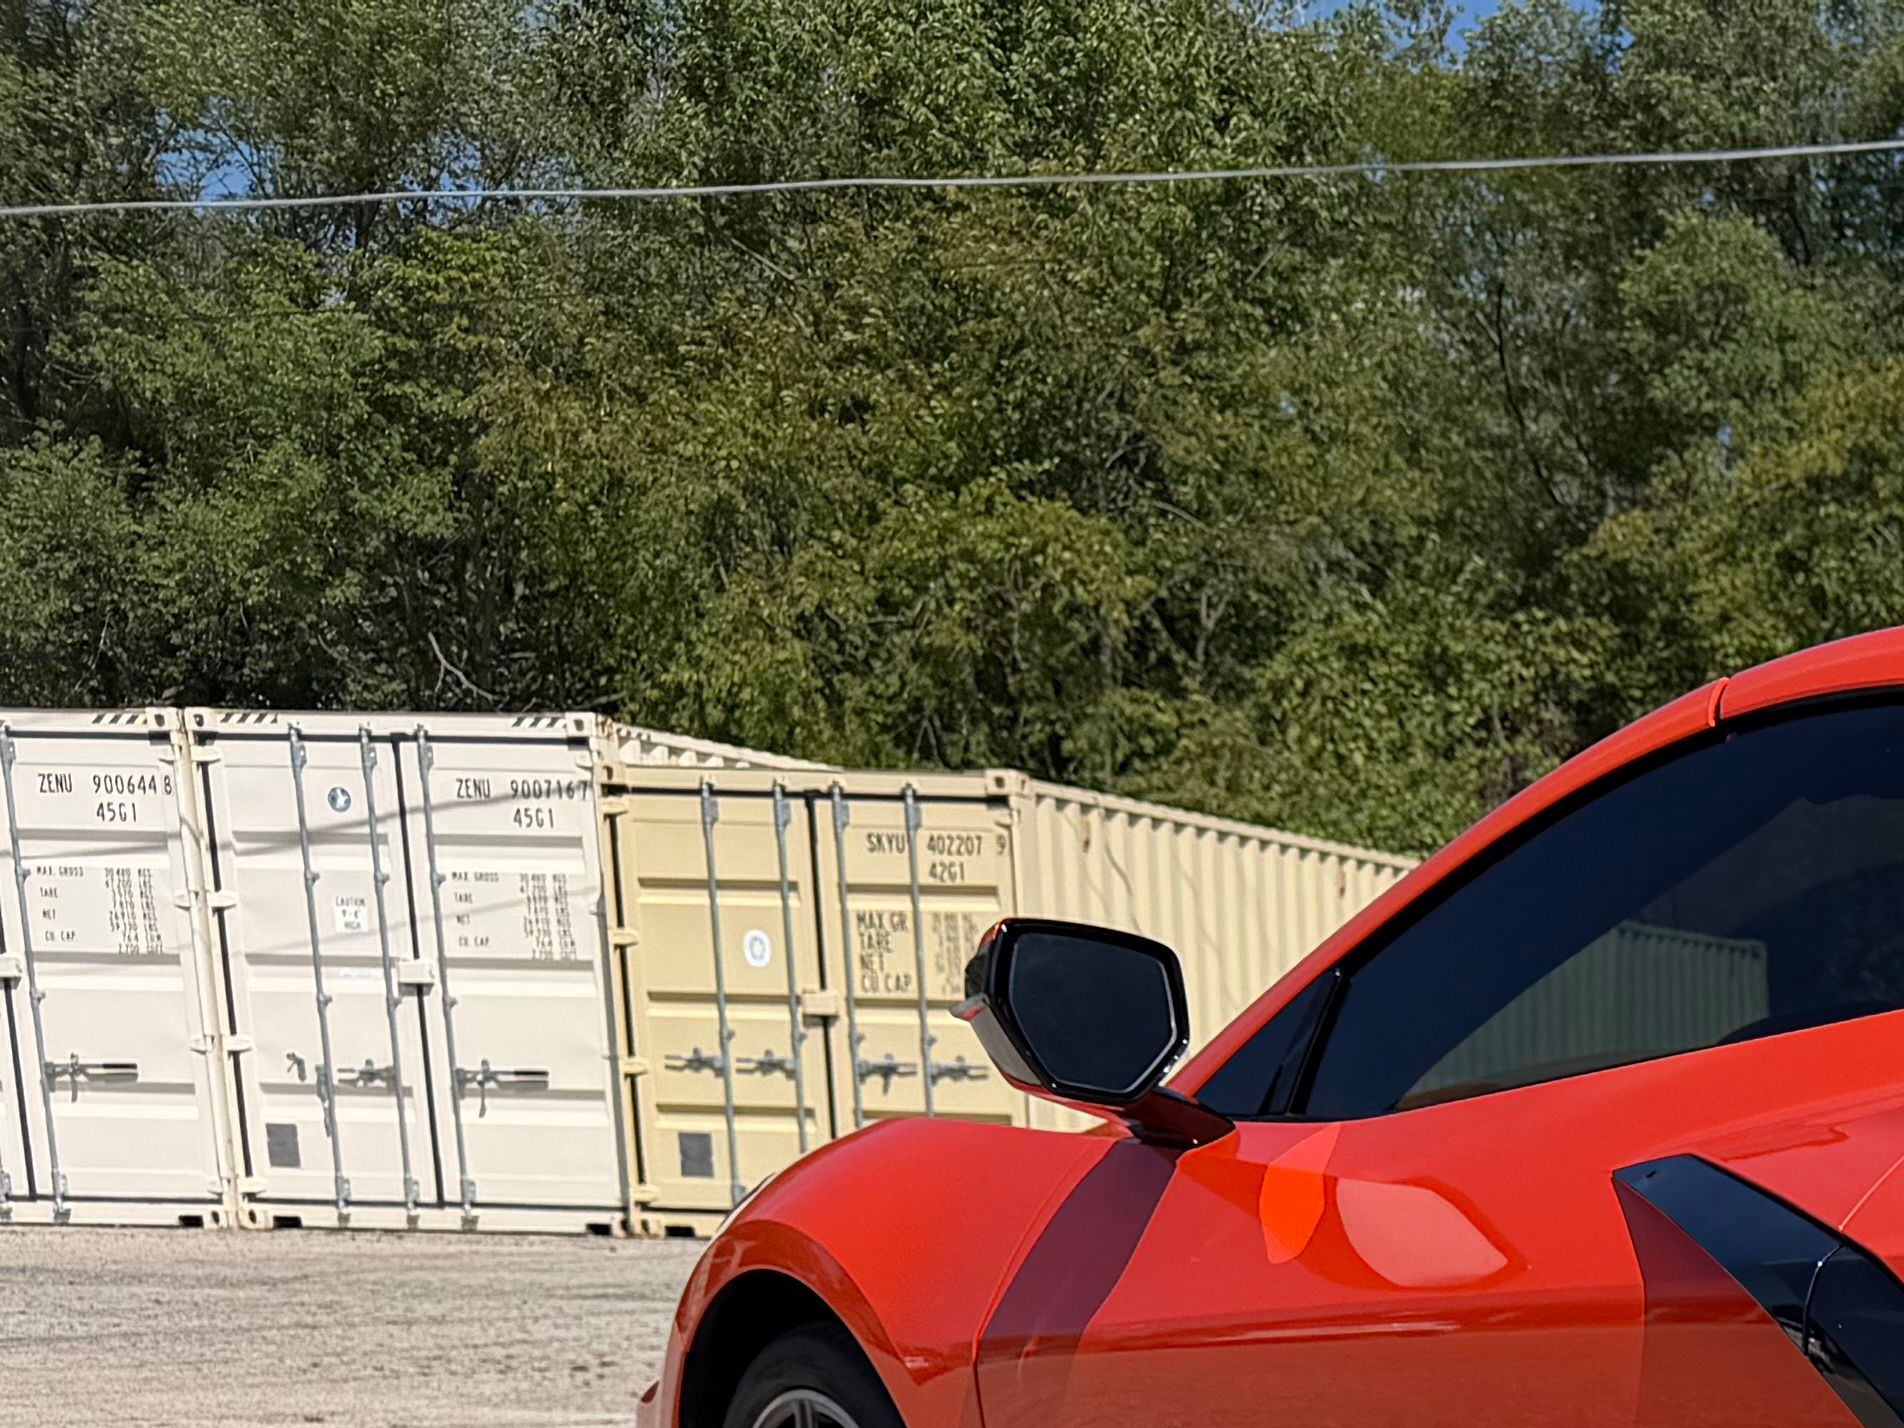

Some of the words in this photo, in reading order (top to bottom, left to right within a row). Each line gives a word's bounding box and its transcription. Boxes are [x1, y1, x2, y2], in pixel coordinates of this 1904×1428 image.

[38, 773, 73, 793] ZENU
[456, 778, 491, 800] ZENU
[96, 802, 137, 822] 45G1
[513, 808, 554, 828] 45G1
[867, 833, 905, 853] SKYU
[927, 834, 982, 855] 402207
